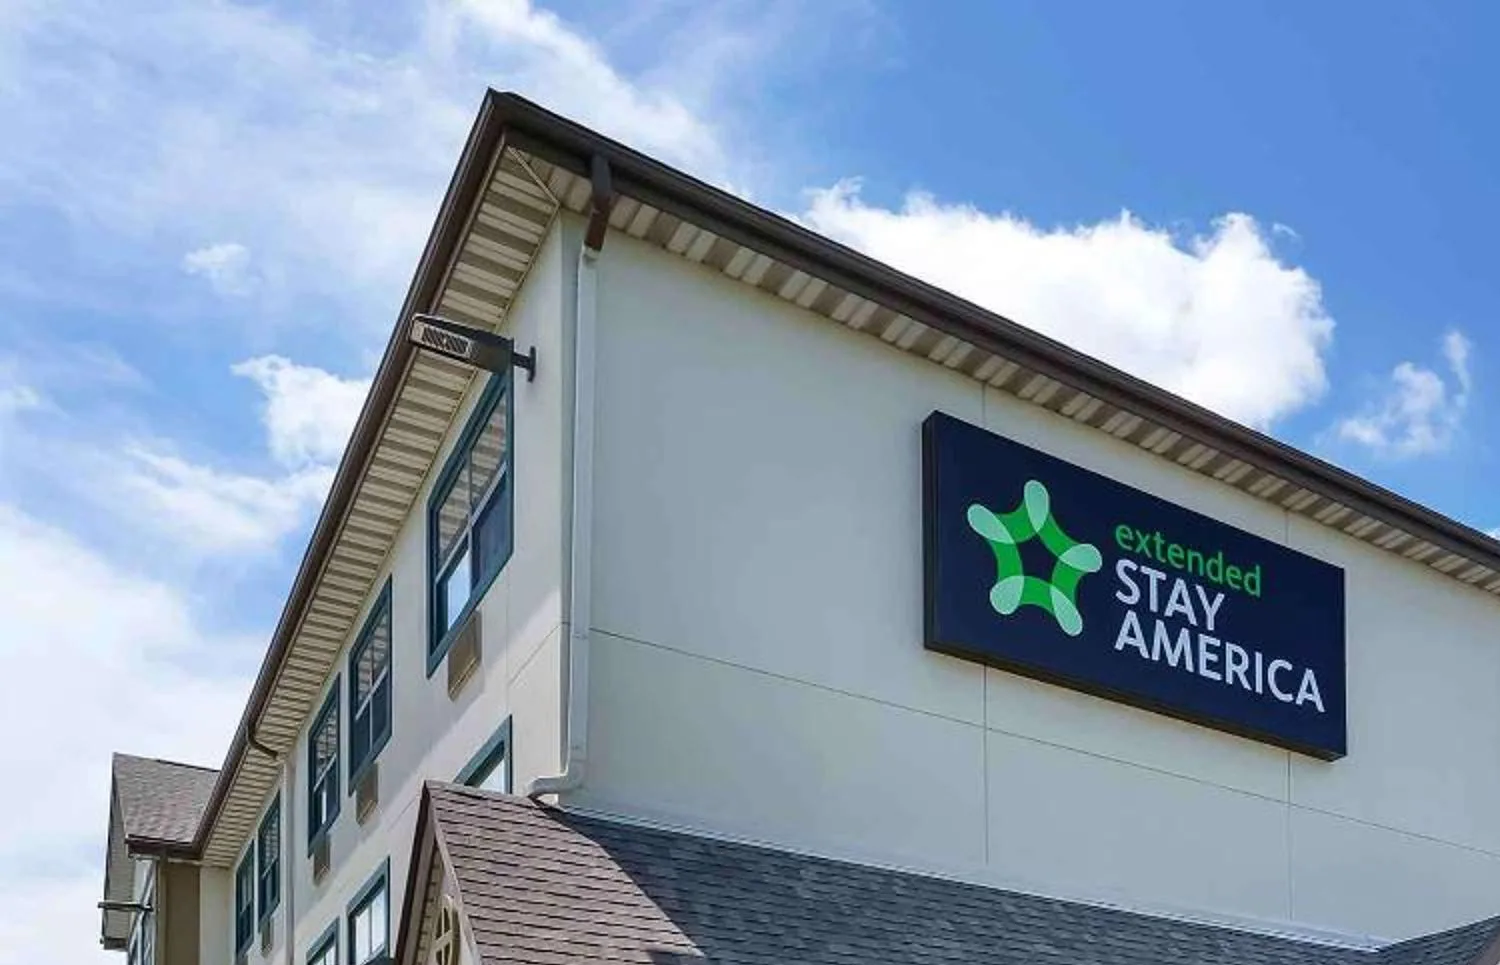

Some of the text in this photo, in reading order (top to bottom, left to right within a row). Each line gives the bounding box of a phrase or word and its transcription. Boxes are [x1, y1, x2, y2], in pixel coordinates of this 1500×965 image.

[1114, 524, 1262, 598] extended
[1114, 558, 1225, 632] STAY
[1113, 609, 1326, 714] AMERICA
